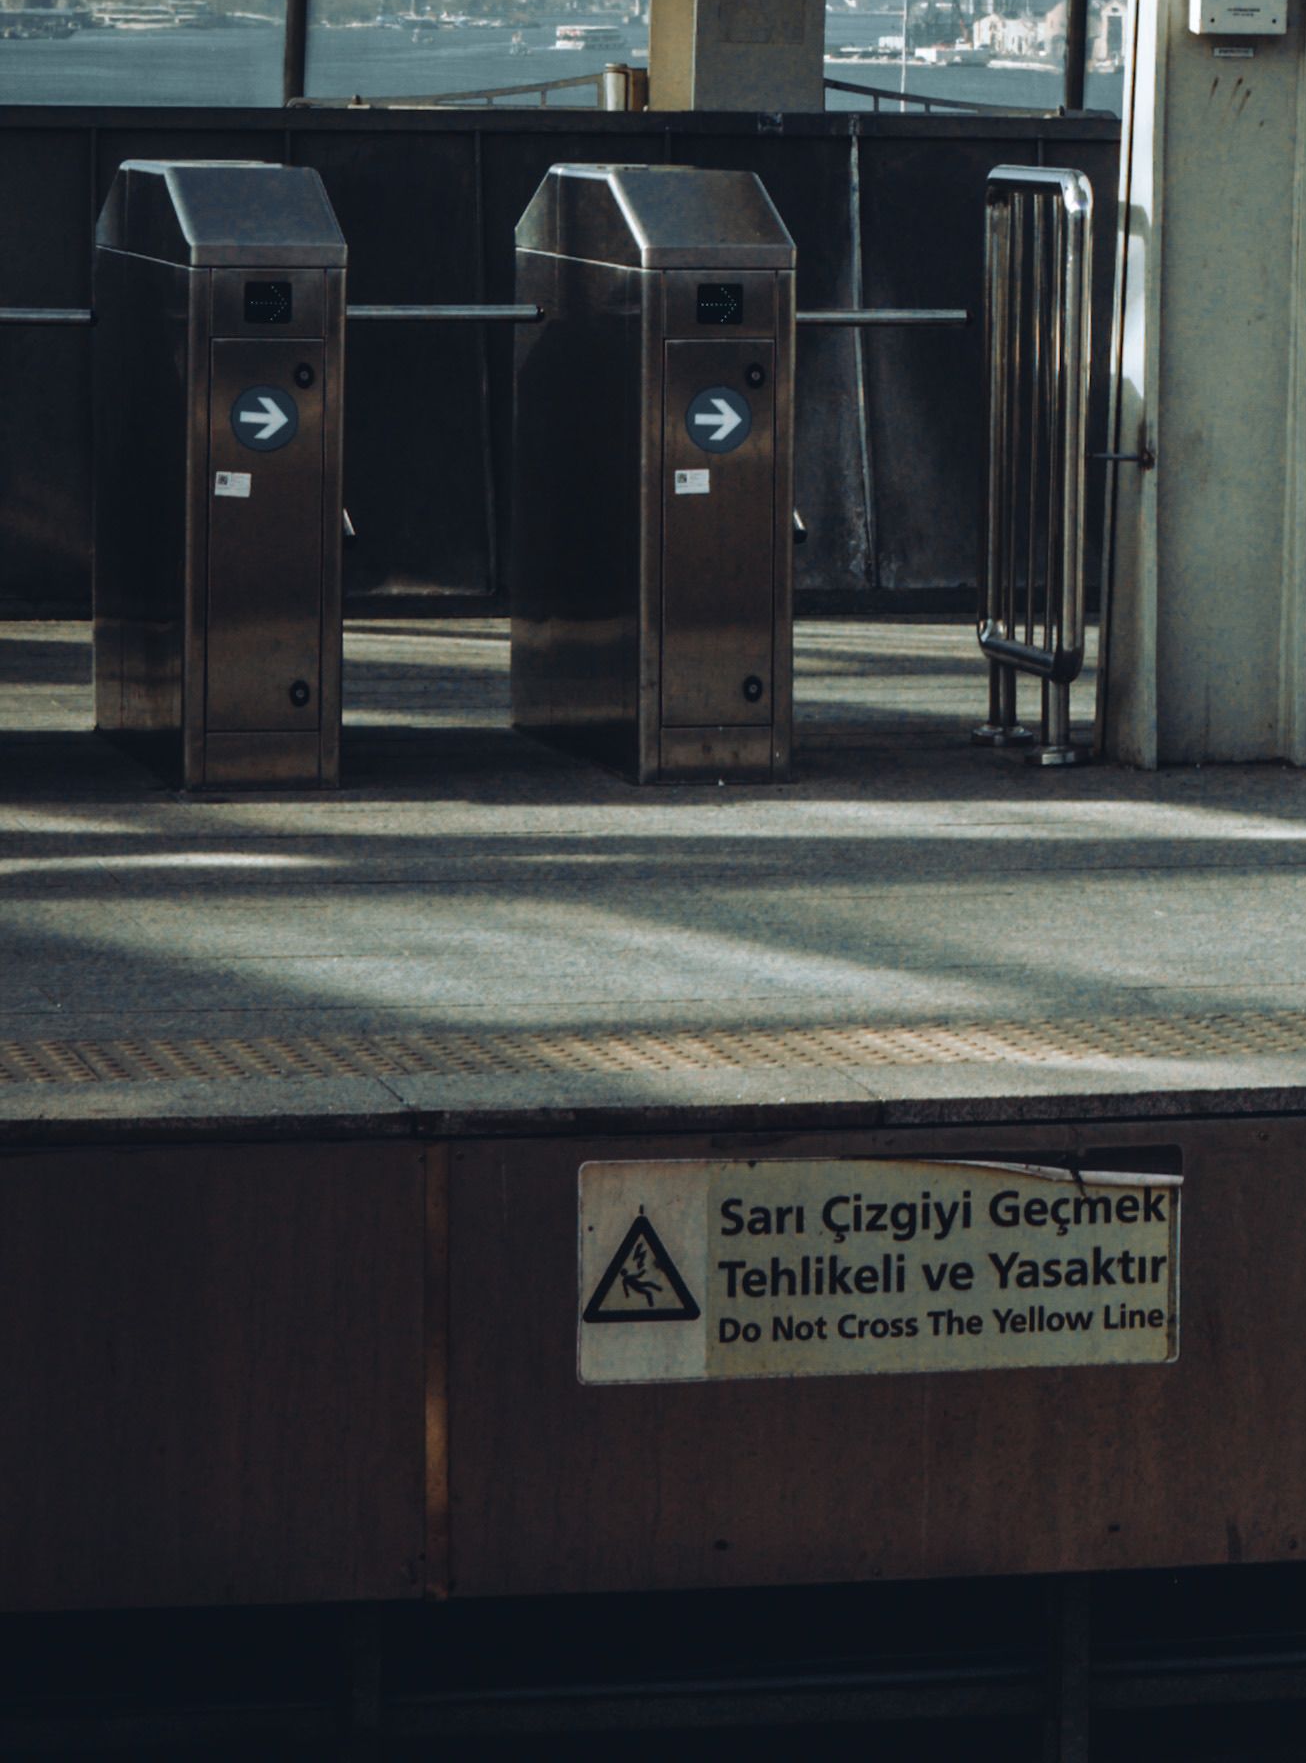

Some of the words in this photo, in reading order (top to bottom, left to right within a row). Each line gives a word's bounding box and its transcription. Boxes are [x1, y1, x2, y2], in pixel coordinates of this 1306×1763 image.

[720, 1197, 805, 1236] Sarı
[822, 1190, 972, 1244] Çizgiyi
[989, 1186, 1167, 1237] Geçmek
[718, 1253, 905, 1298] Tehlikeli
[922, 1261, 974, 1291] ve
[988, 1246, 1167, 1290] Yasaktır
[719, 1317, 762, 1343] Do
[772, 1315, 828, 1342] Not
[837, 1313, 920, 1339] Cross
[927, 1308, 984, 1337] The
[992, 1305, 1094, 1334] Yellow
[1104, 1302, 1165, 1330] Line
